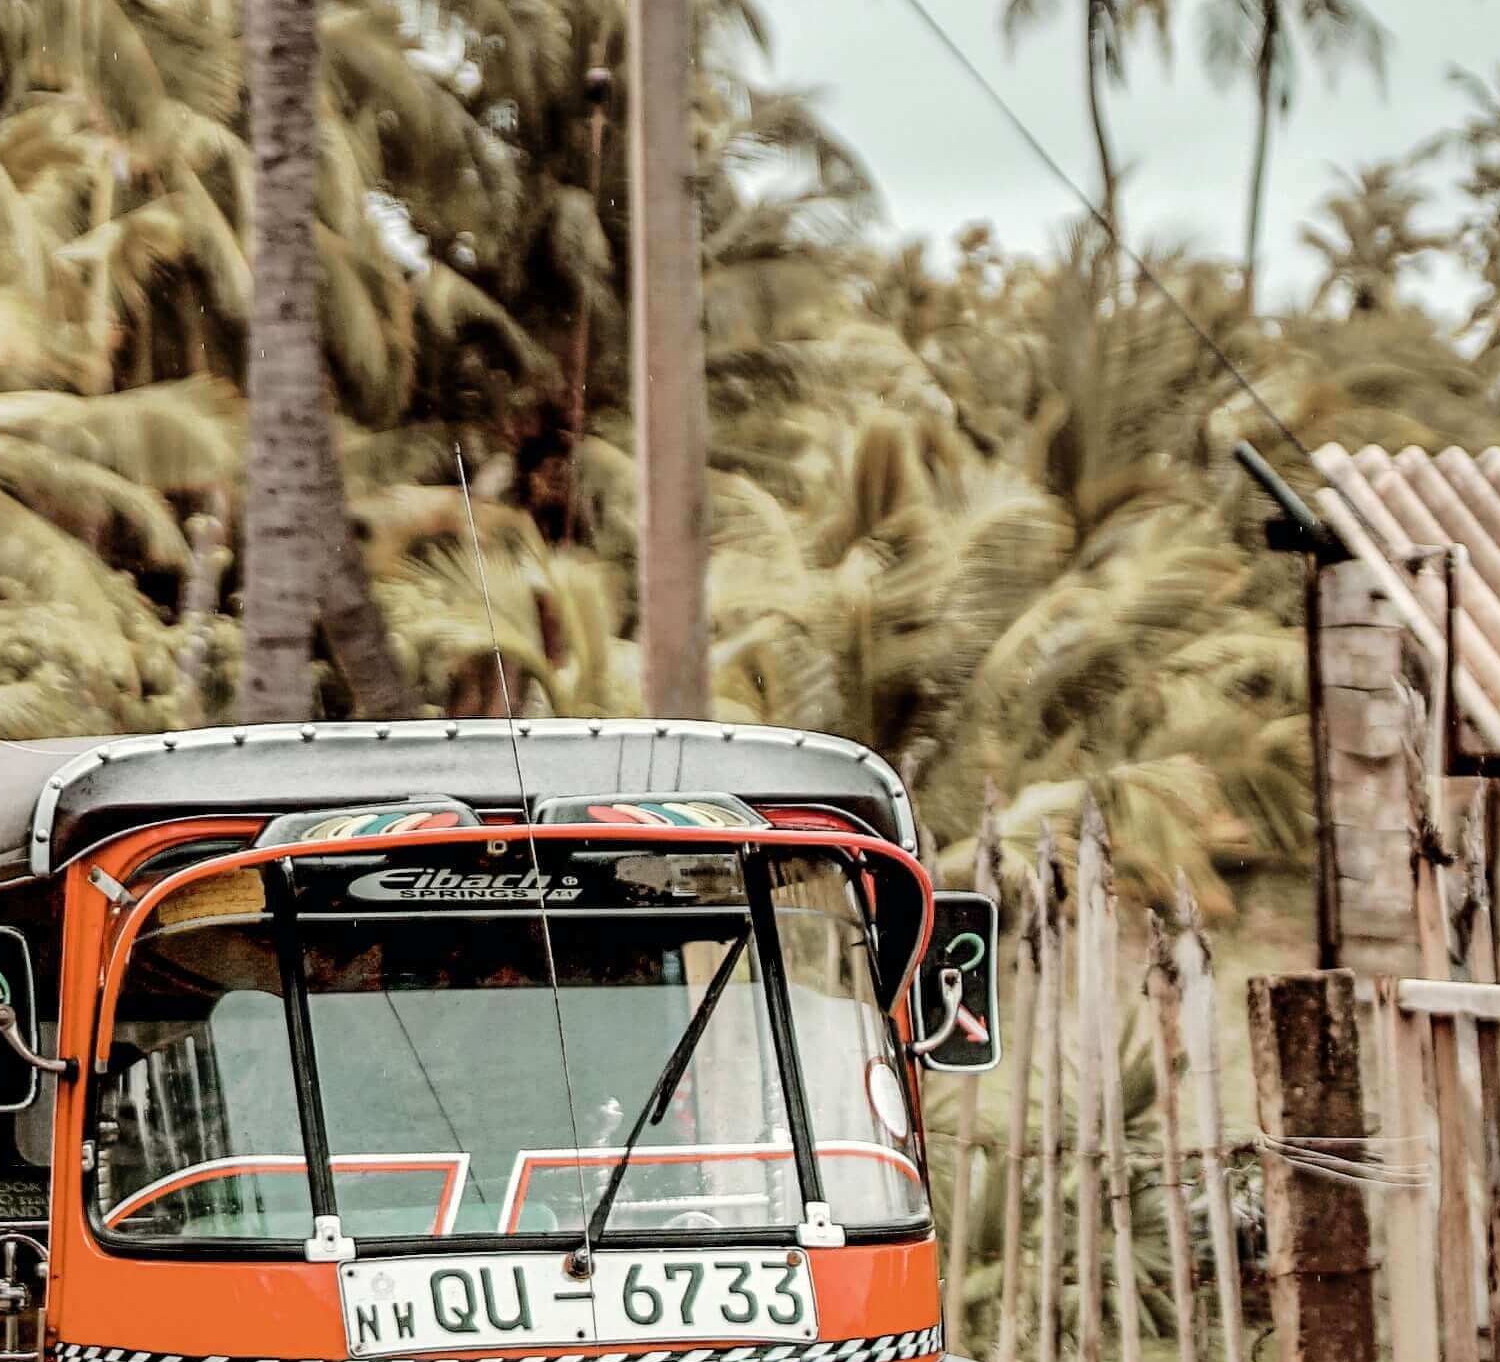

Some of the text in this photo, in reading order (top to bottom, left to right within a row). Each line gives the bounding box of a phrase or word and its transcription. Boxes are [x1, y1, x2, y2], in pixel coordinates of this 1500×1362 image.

[348, 868, 552, 891] Eibach
[399, 889, 530, 899] SPRINGS
[429, 1265, 533, 1333] QU
[622, 1261, 804, 1327] 6733
